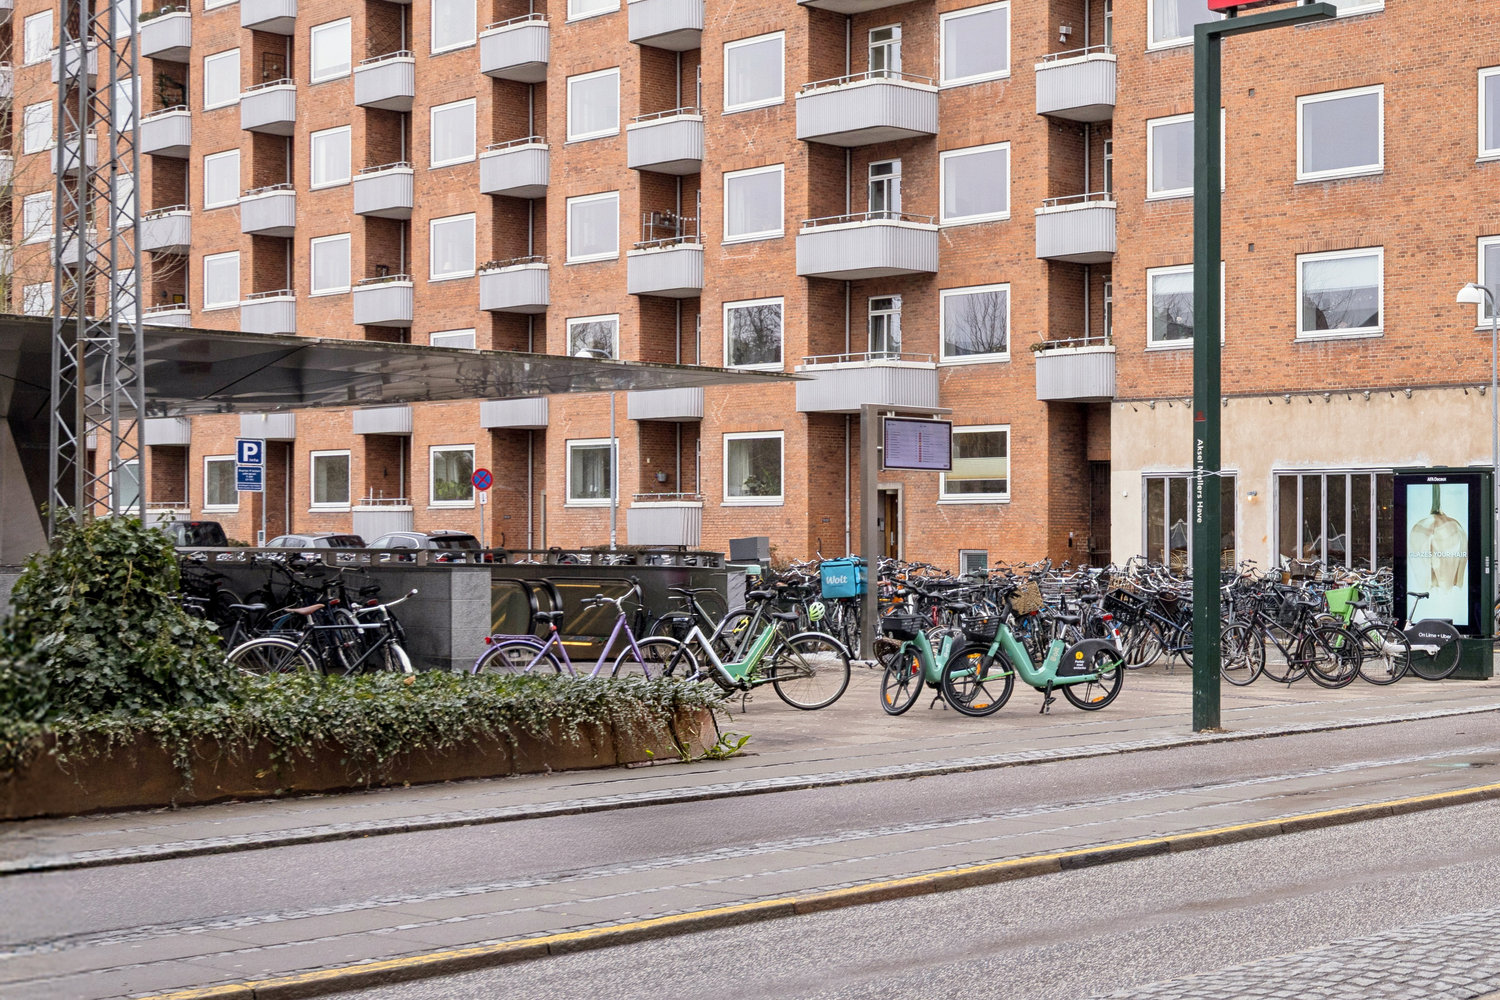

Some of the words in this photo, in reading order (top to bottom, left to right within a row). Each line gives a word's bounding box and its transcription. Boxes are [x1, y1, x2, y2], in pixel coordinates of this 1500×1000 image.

[243, 442, 259, 462] P
[1196, 501, 1204, 524] Have
[1434, 551, 1452, 559] YOUR
[1453, 551, 1468, 559] HAIR
[825, 575, 848, 585] Wolt
